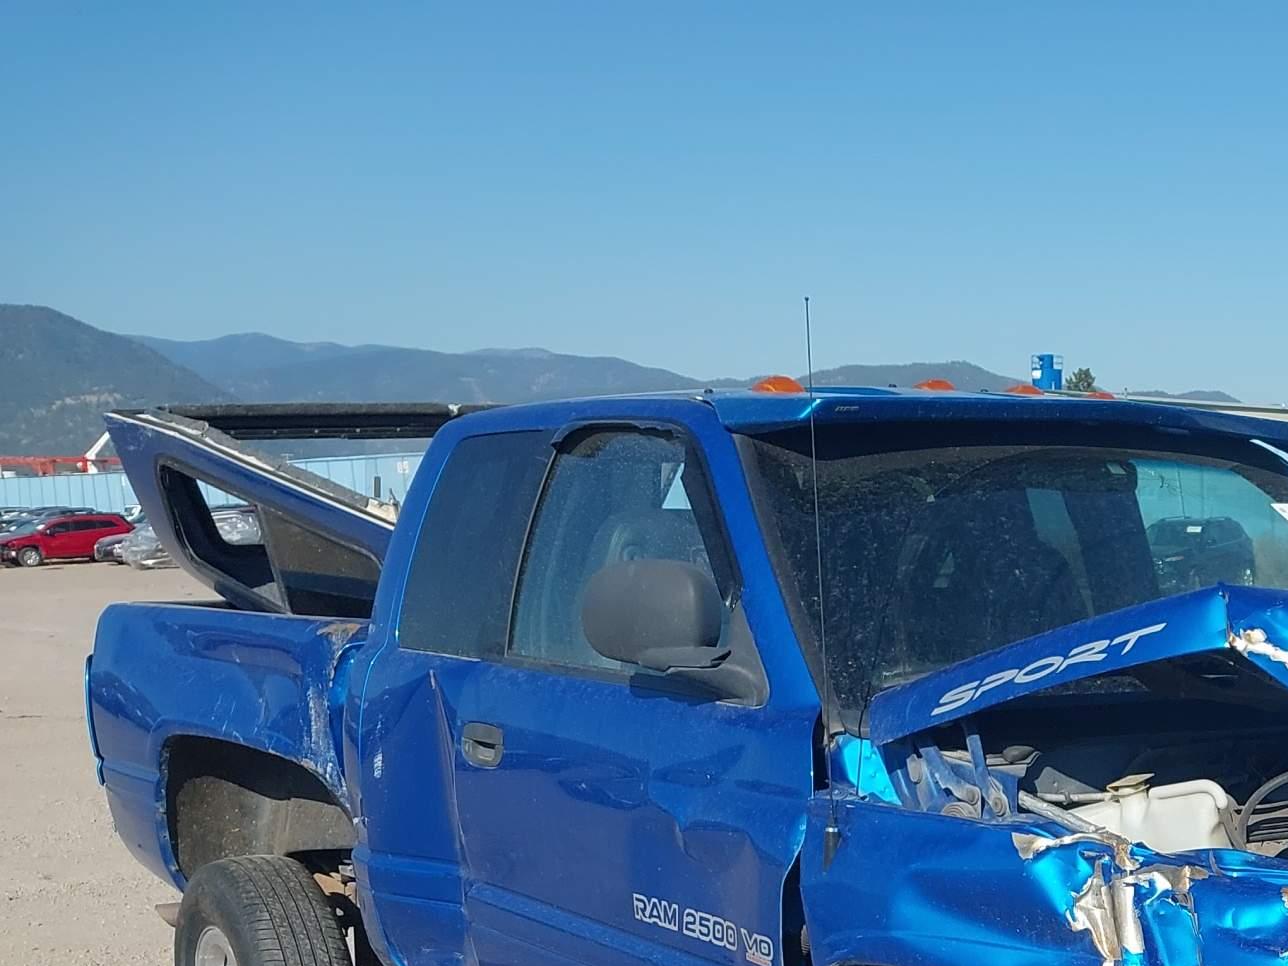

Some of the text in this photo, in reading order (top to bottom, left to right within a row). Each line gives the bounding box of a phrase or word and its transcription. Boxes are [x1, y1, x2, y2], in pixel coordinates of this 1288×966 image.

[930, 622, 1168, 717] SPORT
[632, 893, 679, 932] RAM
[683, 909, 738, 951] 2500
